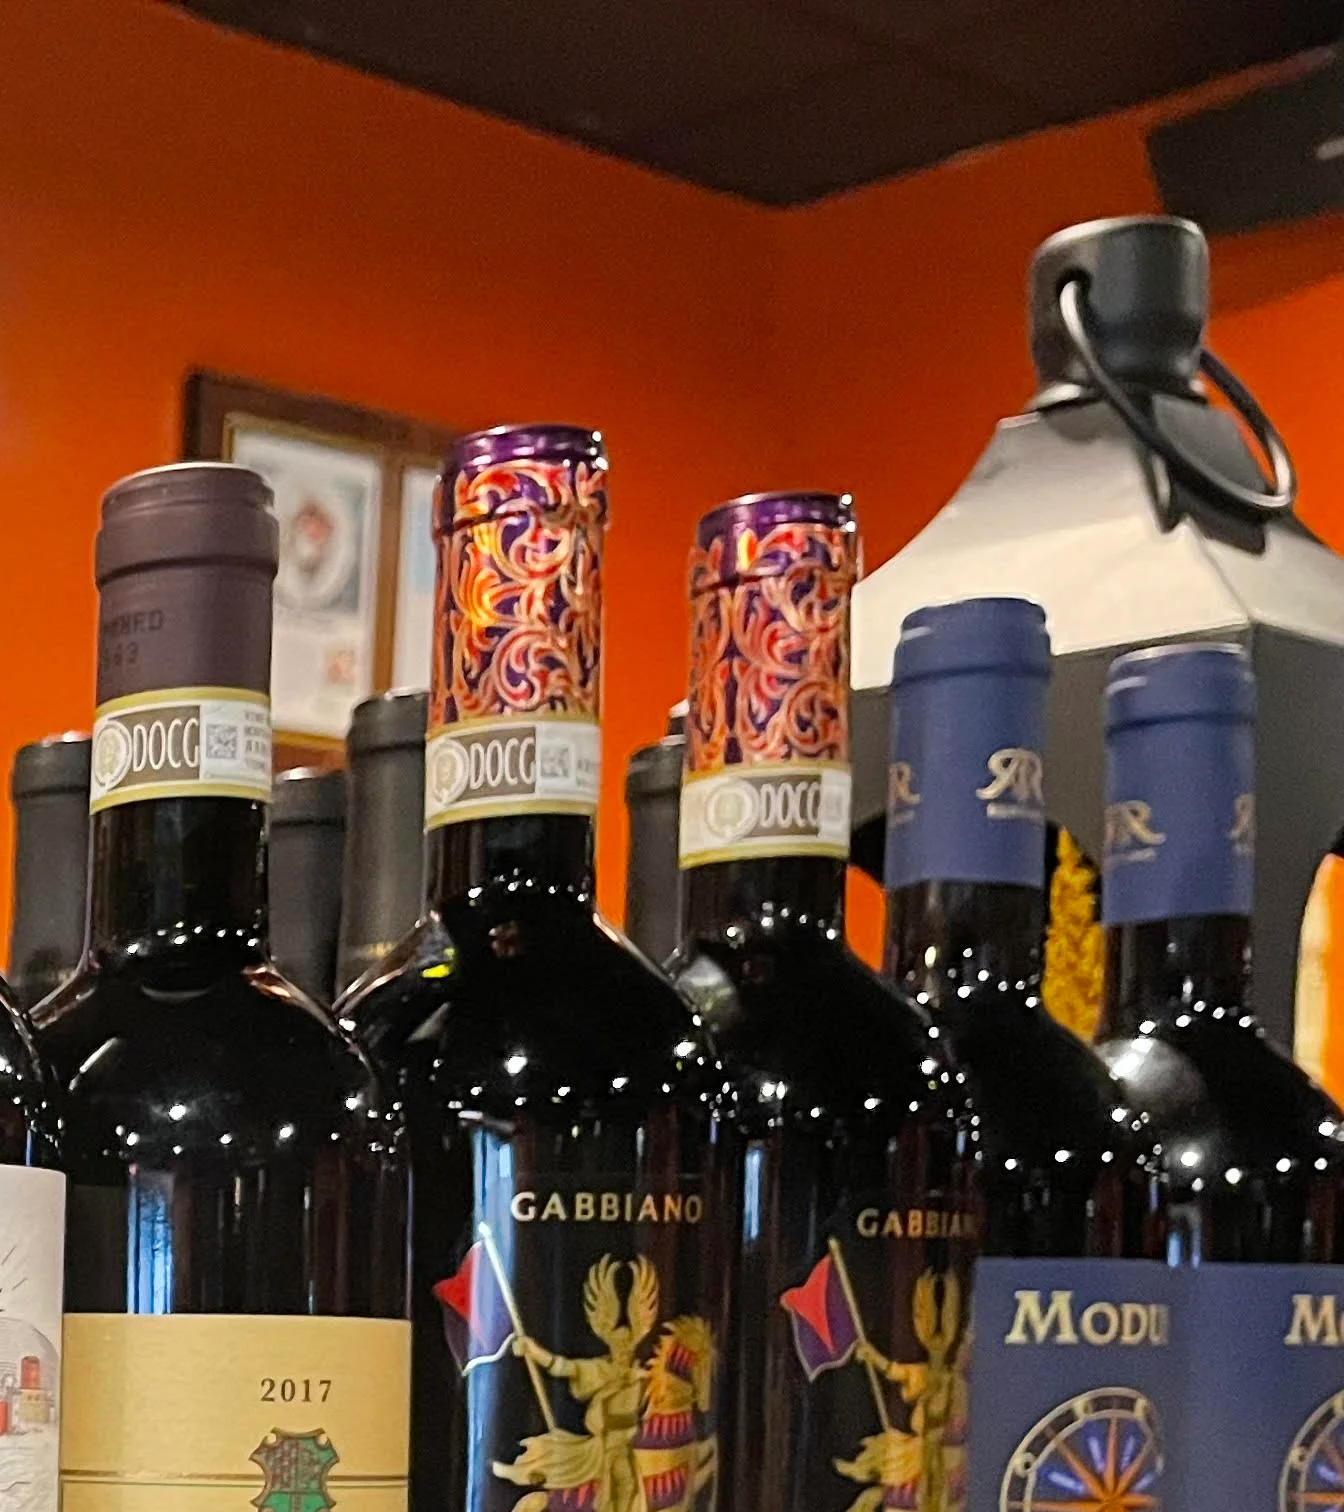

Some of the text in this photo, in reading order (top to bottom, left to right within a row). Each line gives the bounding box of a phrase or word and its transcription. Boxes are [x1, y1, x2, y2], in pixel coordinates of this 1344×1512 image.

[131, 717, 199, 774] DOCG
[469, 737, 536, 789] DOCG
[511, 1190, 705, 1225] GABBIANO
[1004, 1290, 1169, 1346] MODU
[260, 1378, 333, 1403] 2017
